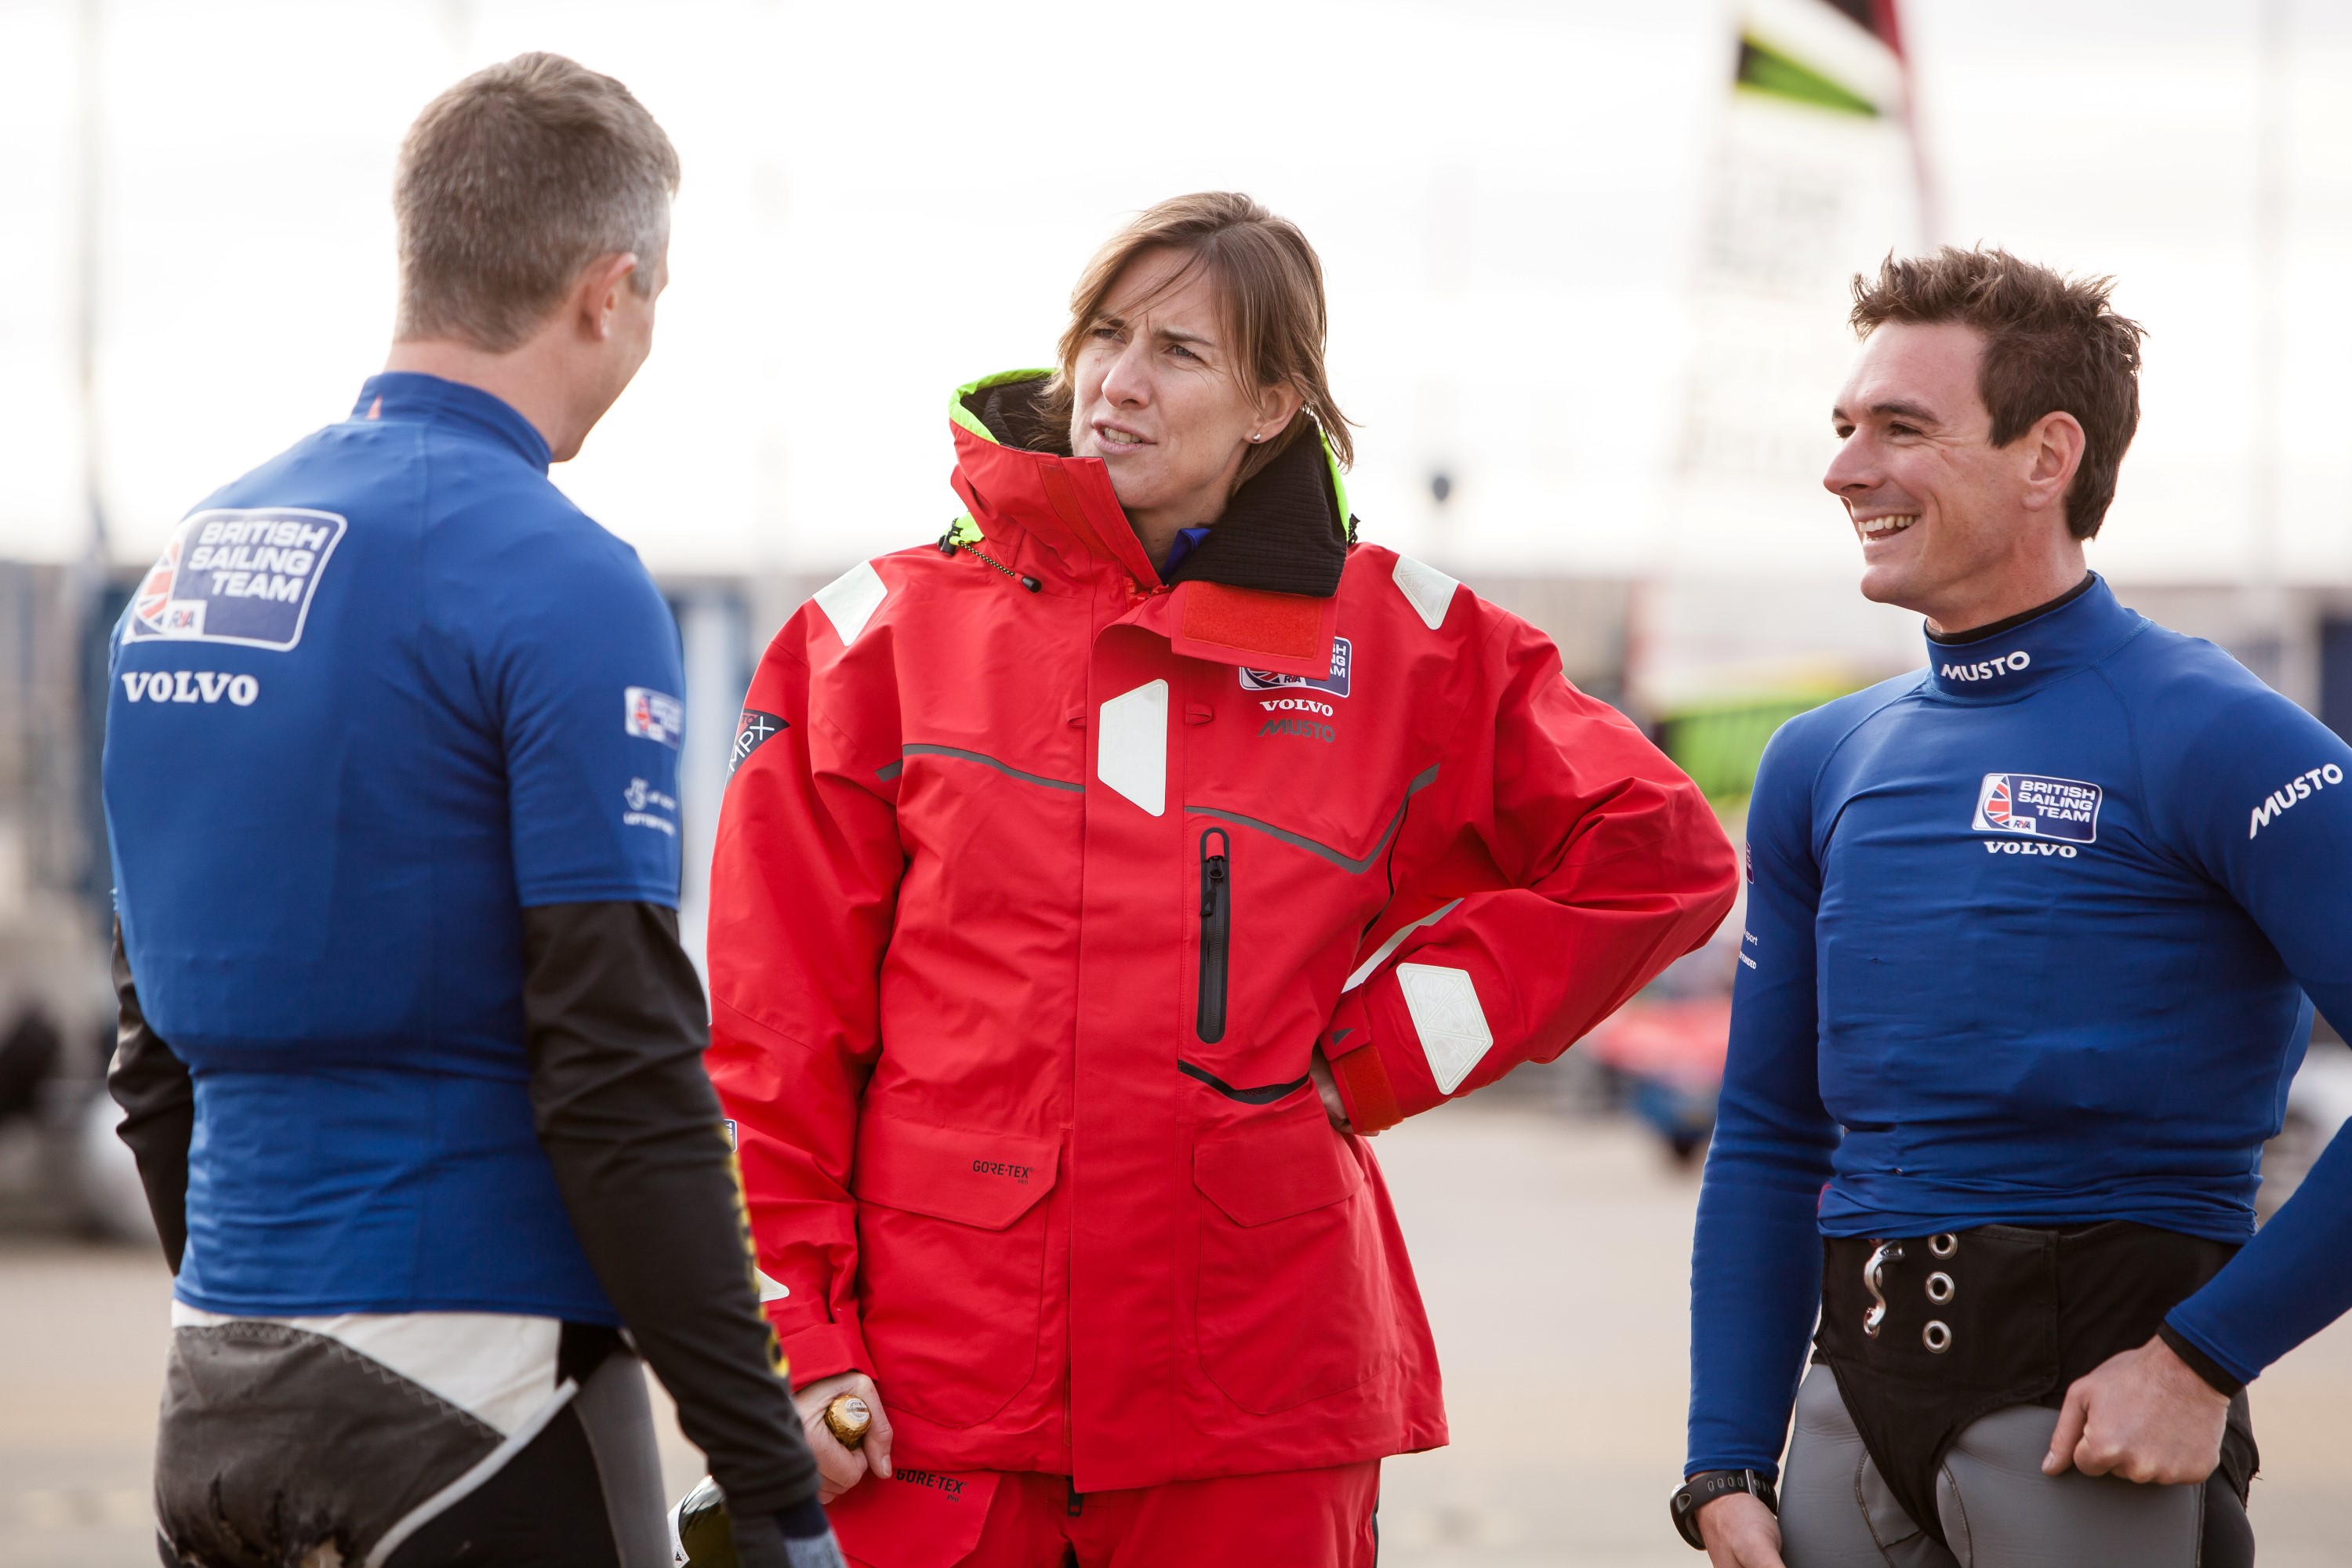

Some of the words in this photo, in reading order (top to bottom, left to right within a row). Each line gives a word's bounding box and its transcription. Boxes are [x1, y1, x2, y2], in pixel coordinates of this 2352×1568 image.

[198, 521, 330, 550] BRITISH
[188, 546, 315, 576] SAILING
[212, 571, 305, 604] TEAM
[1941, 651, 2031, 681] MUSTO
[121, 670, 260, 706] VOLVO
[1260, 699, 1334, 717] VOLVO
[1258, 718, 1335, 742] MUSTO
[2017, 792, 2093, 811] SAILING
[2020, 780, 2096, 800] BRITISH
[2249, 763, 2343, 840] MUSTO
[2036, 805, 2091, 822] TEAM
[1984, 841, 2078, 858] VOLVO
